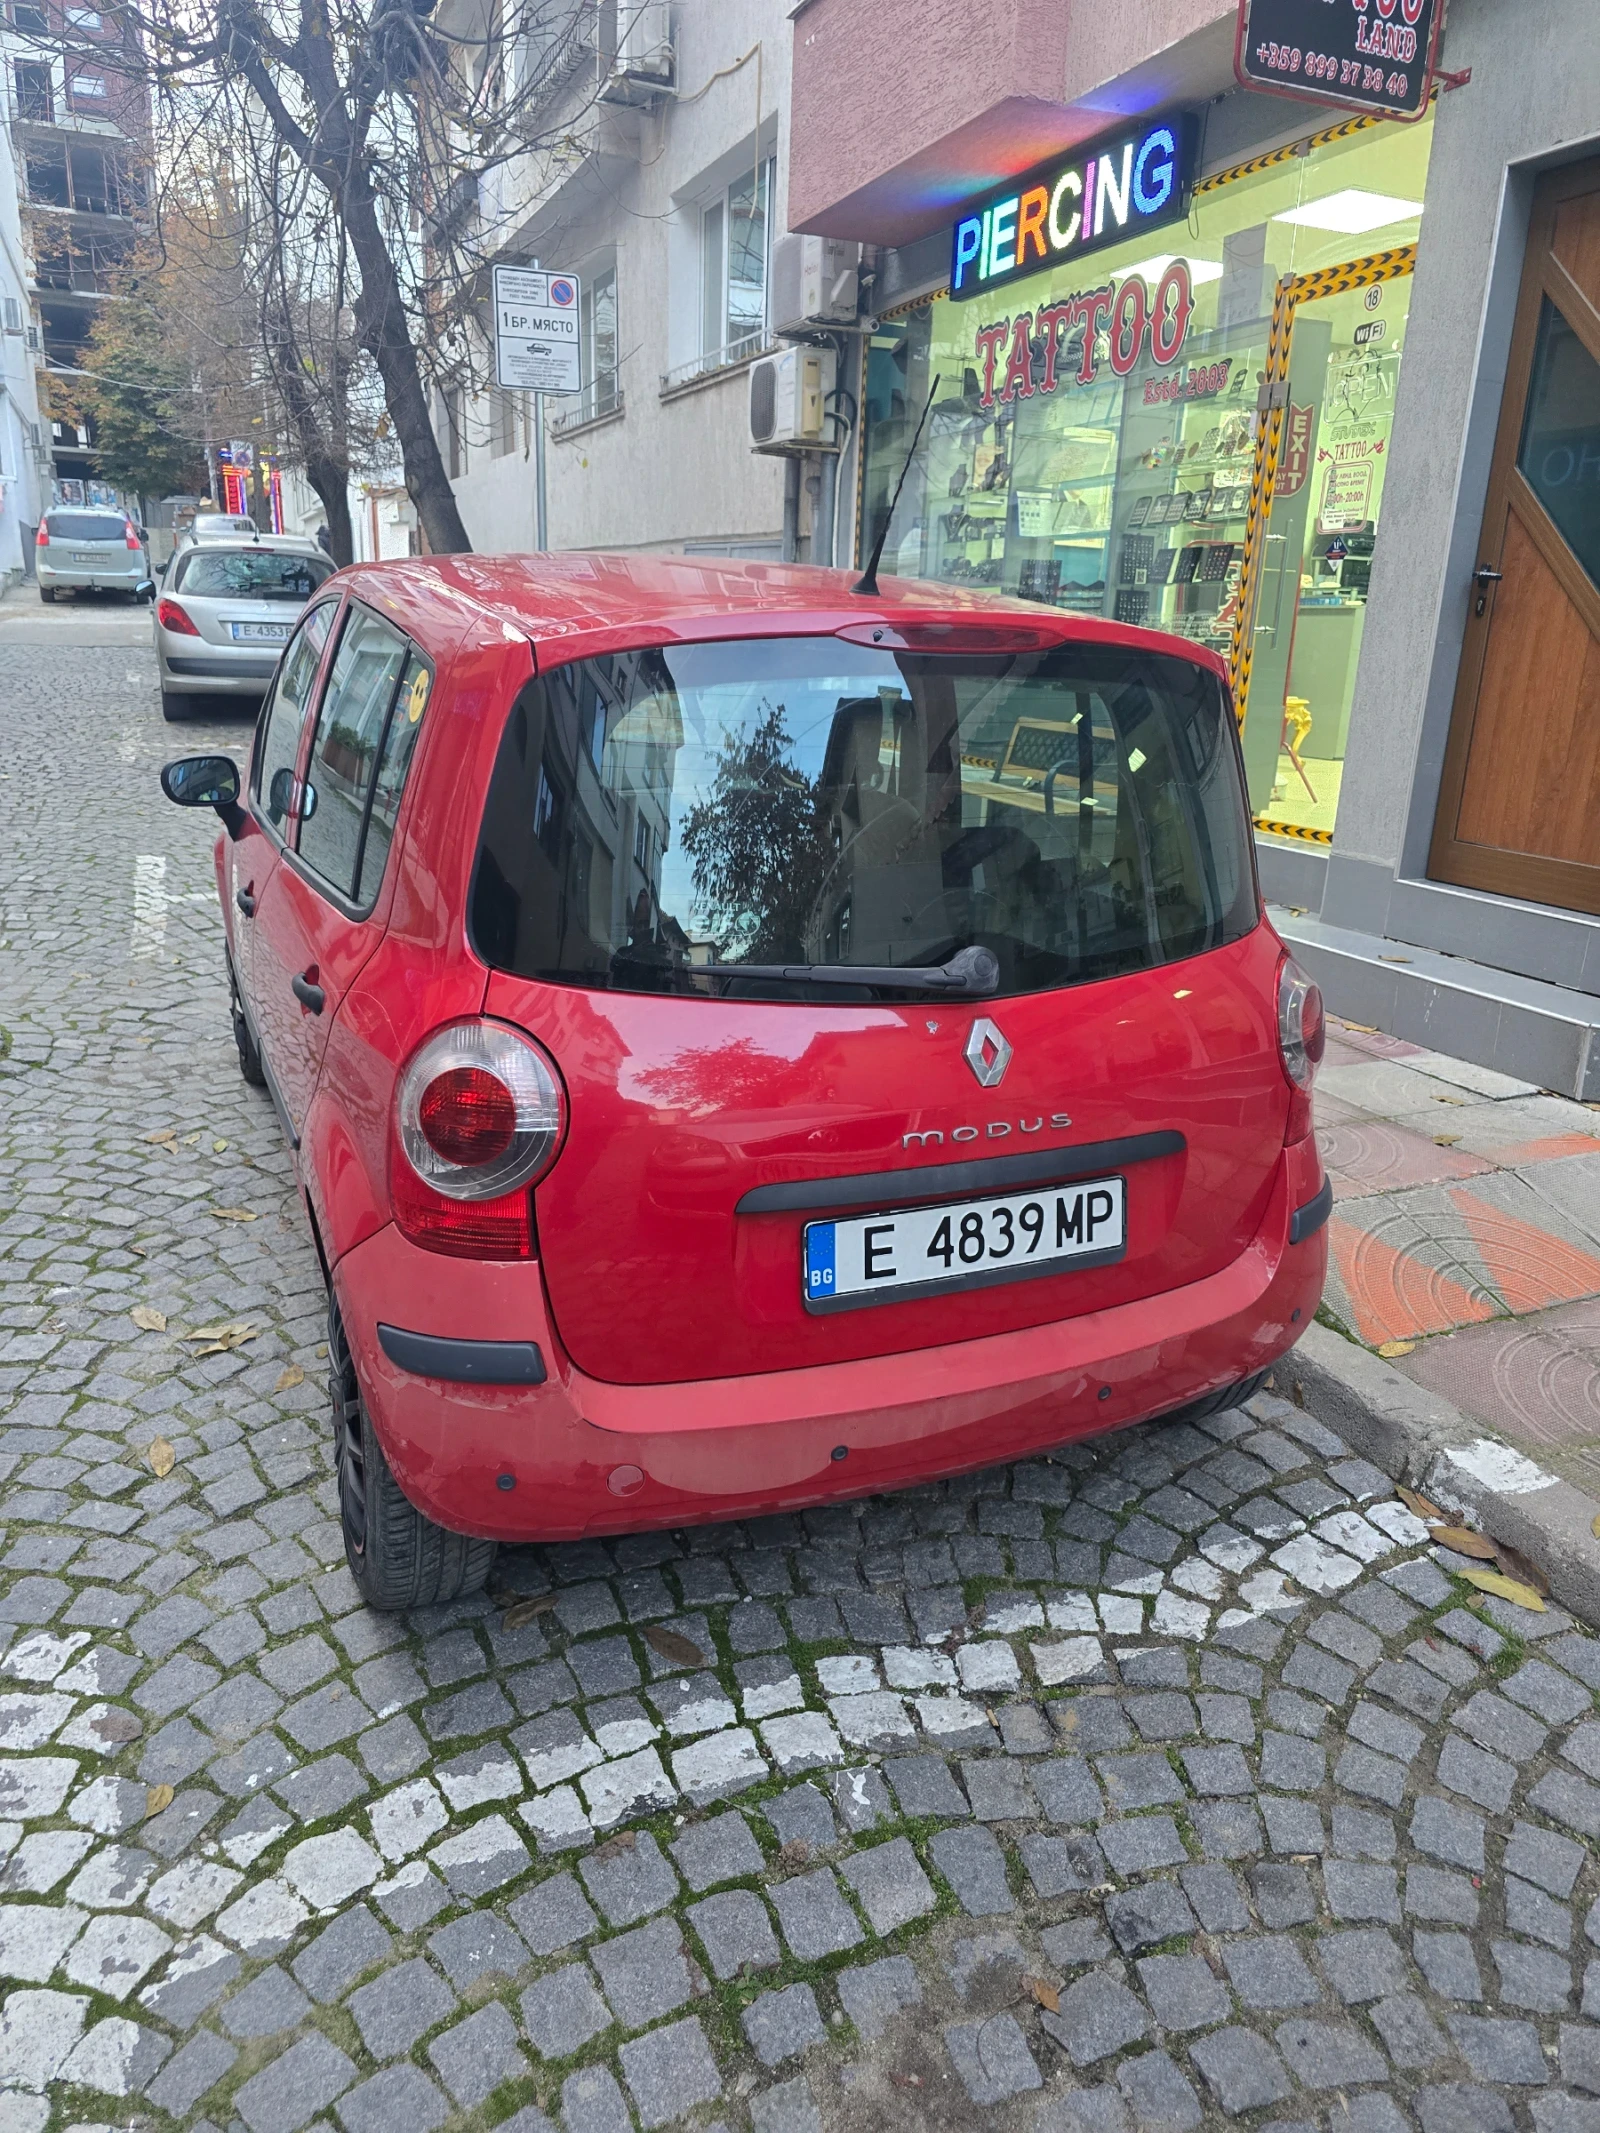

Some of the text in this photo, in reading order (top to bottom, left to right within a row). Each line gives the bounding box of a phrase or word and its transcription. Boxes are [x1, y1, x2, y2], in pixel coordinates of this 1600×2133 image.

[1355, 16, 1417, 63] LAND
[1256, 42, 1407, 98] +359 899 37 38 40
[954, 129, 1175, 290] PIERCING
[1367, 289, 1379, 307] 18
[503, 311, 573, 334] 1 БР. МЯСТО
[976, 257, 1195, 409] TATTOO
[1142, 358, 1232, 405] Estd. 2003
[1333, 372, 1394, 406] OPEN
[1288, 414, 1308, 490] EXIT
[1335, 440, 1367, 460] TATTOO
[244, 625, 252, 636] E
[257, 626, 283, 637] 4353
[901, 1112, 1073, 1149] MODUS
[864, 1189, 1114, 1280] E 4839 MP
[810, 1268, 833, 1286] BG
